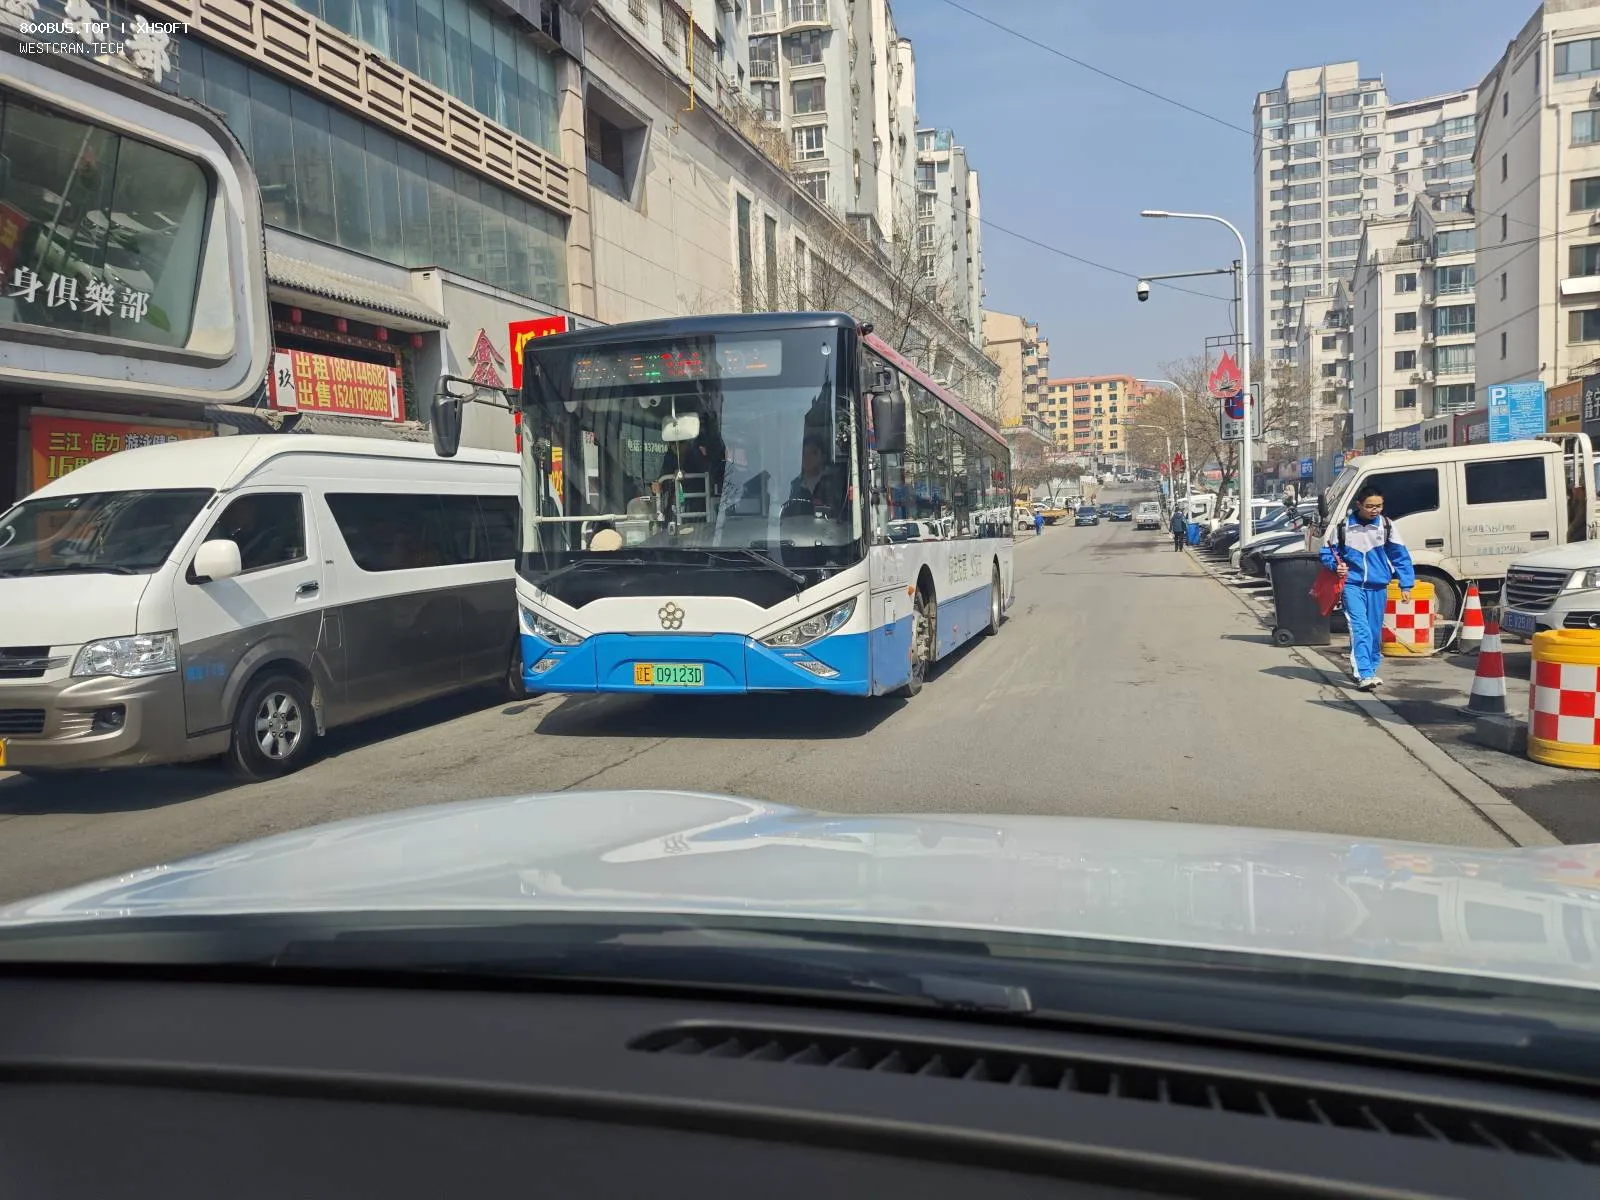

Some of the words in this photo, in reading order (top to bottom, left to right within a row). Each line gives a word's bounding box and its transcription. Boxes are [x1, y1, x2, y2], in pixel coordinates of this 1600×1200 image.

[0, 265, 150, 324] 身俱樂部
[295, 352, 330, 381] 出租
[298, 380, 331, 408] 出售
[656, 667, 702, 683] 09123D
